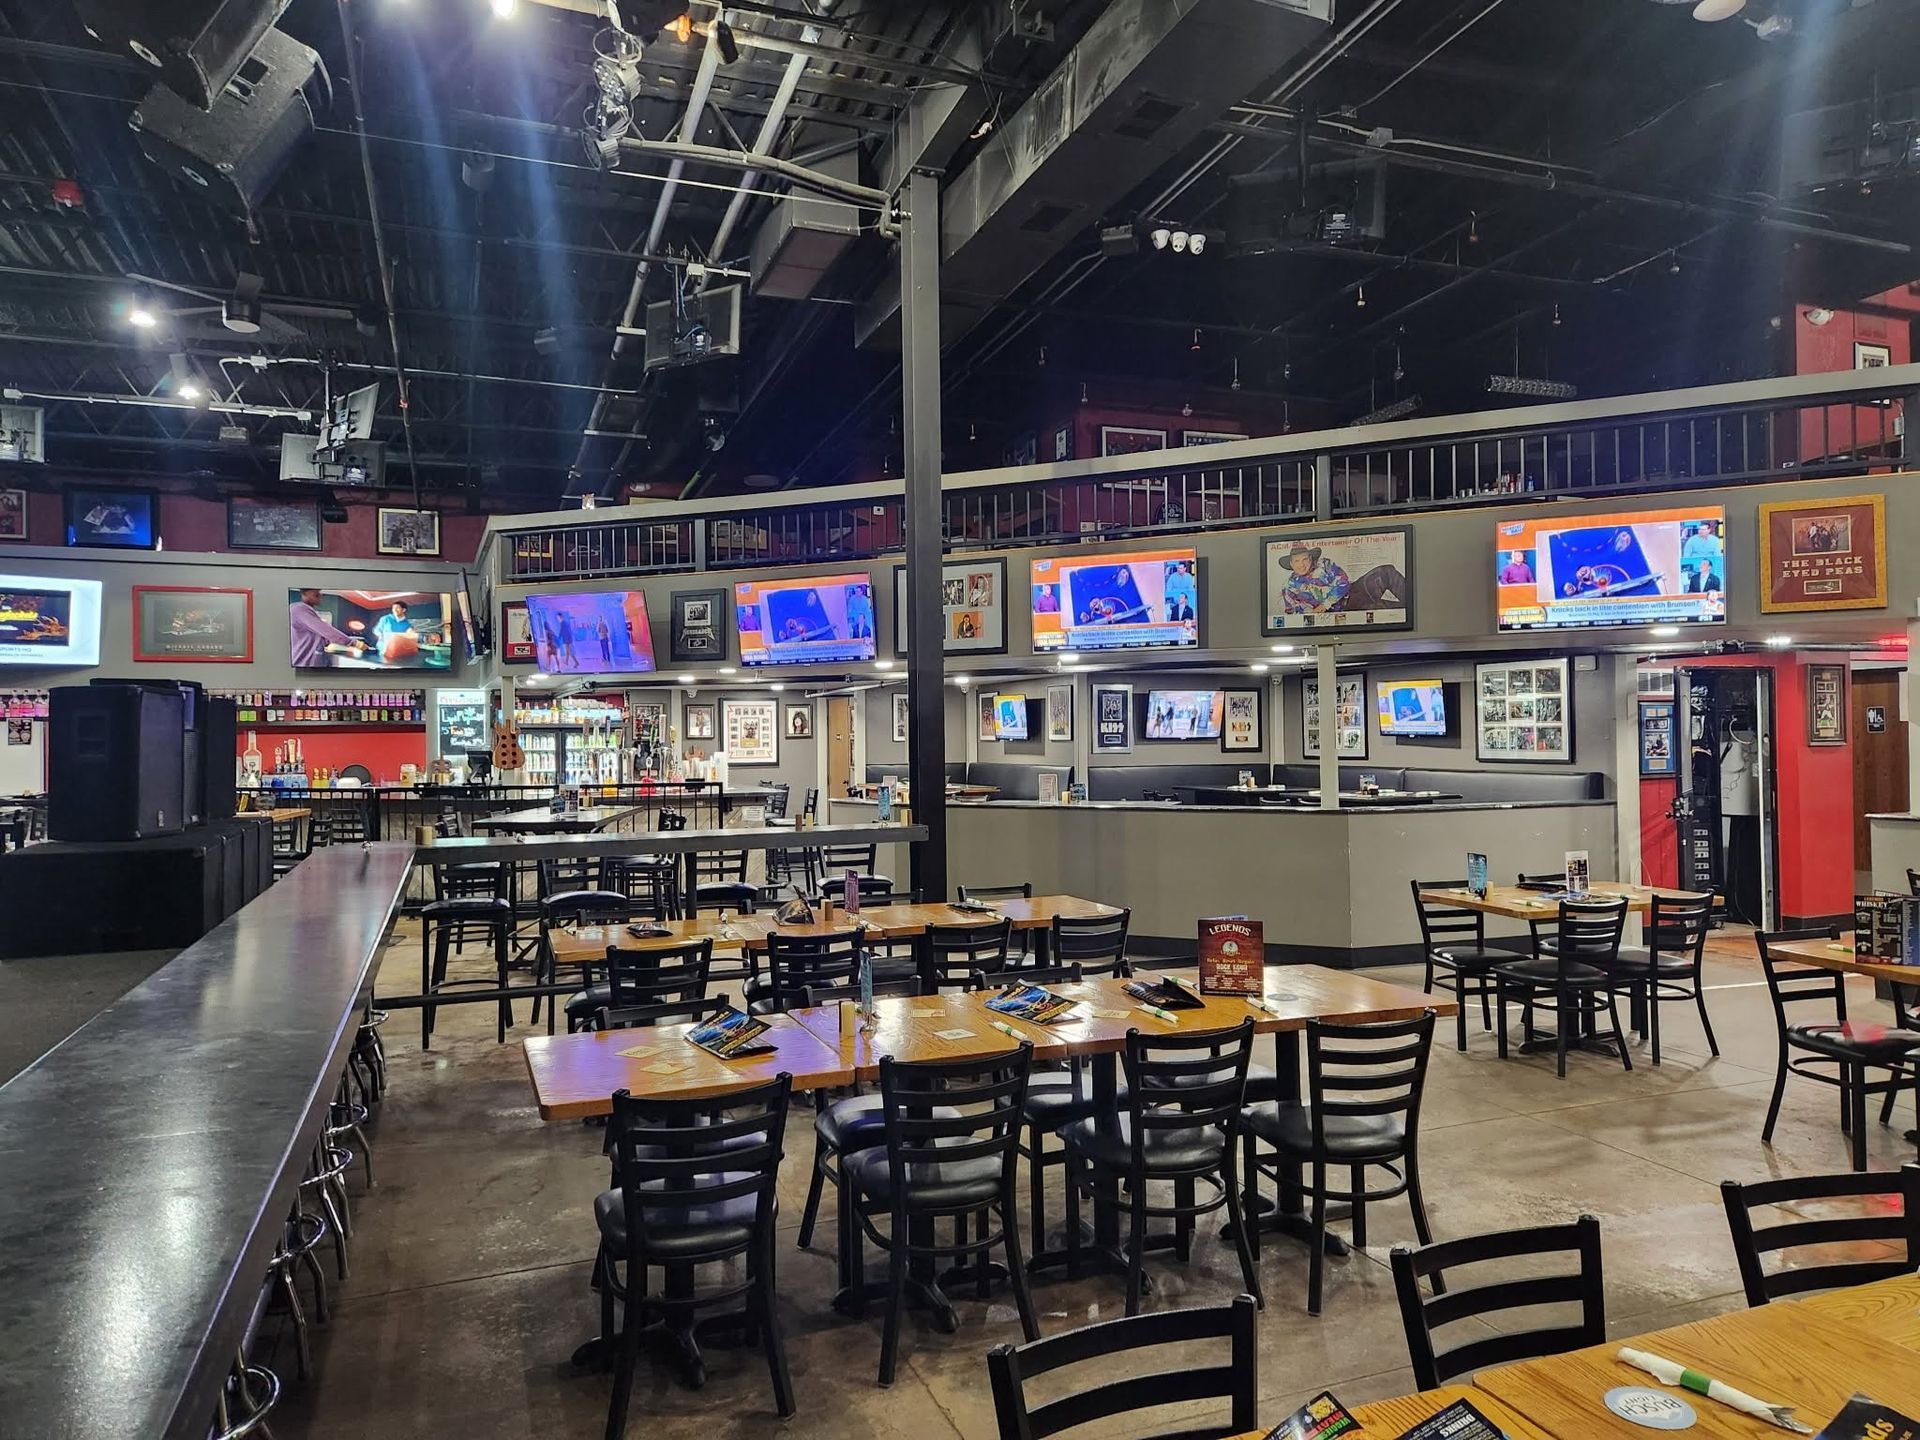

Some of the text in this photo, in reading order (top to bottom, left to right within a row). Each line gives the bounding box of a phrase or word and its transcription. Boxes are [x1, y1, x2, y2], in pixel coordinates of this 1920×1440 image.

[1311, 539, 1353, 548] Entertainer
[1782, 556, 1863, 568] THE BLACK
[1782, 566, 1863, 578] EYED PEAS
[1574, 605, 1591, 613] back
[1612, 602, 1651, 611] contention
[1100, 722, 1125, 734] KISS
[1231, 721, 1252, 733] KISS
[1209, 924, 1252, 936] LEGENDS
[1624, 1393, 1657, 1405] LIGHT
[1618, 1397, 1682, 1416] BUSCH
[1439, 1413, 1477, 1438] DRINKS
